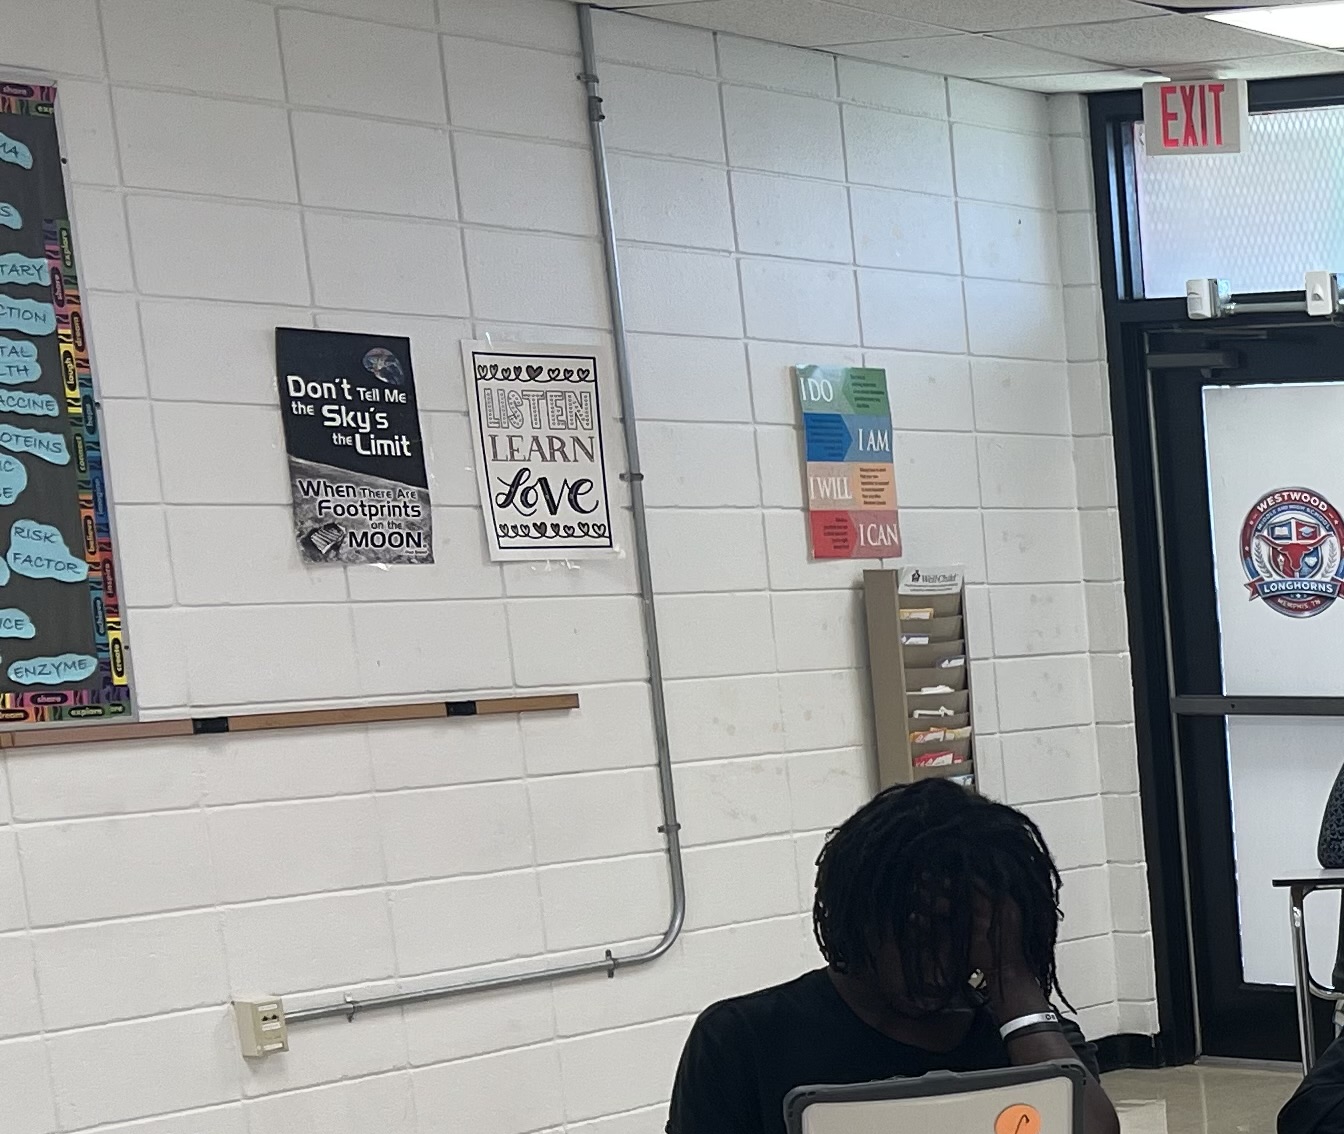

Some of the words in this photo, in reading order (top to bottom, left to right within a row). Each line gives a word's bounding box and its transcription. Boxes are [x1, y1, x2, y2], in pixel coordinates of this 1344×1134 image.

[1160, 84, 1225, 148] EXIT
[286, 375, 352, 400] Don't
[356, 387, 379, 401] Tell
[385, 389, 406, 403] Me
[800, 378, 806, 400] I
[808, 379, 833, 402] DO
[291, 401, 314, 415] the
[322, 405, 388, 432] Sky's
[484, 388, 593, 430] LISTEN
[332, 433, 352, 446] the
[355, 434, 411, 456] Limit
[488, 435, 594, 462] LEARN
[858, 428, 864, 451] I
[867, 429, 890, 451] AM
[298, 479, 356, 498] When
[360, 488, 392, 499] There
[398, 489, 416, 499] Are
[809, 477, 815, 499] I
[816, 477, 852, 499] WILL
[317, 500, 421, 520] Footprints
[1256, 491, 1329, 513] WESTWOOD
[14, 527, 57, 544] RISK
[371, 521, 383, 530] on
[387, 520, 402, 529] the
[859, 524, 866, 546] I
[867, 524, 899, 546] CAN
[349, 532, 427, 548] MOON.
[13, 552, 81, 574] FACTOR
[1263, 581, 1334, 593] LONGHORNS
[14, 659, 87, 678] ENZYME
